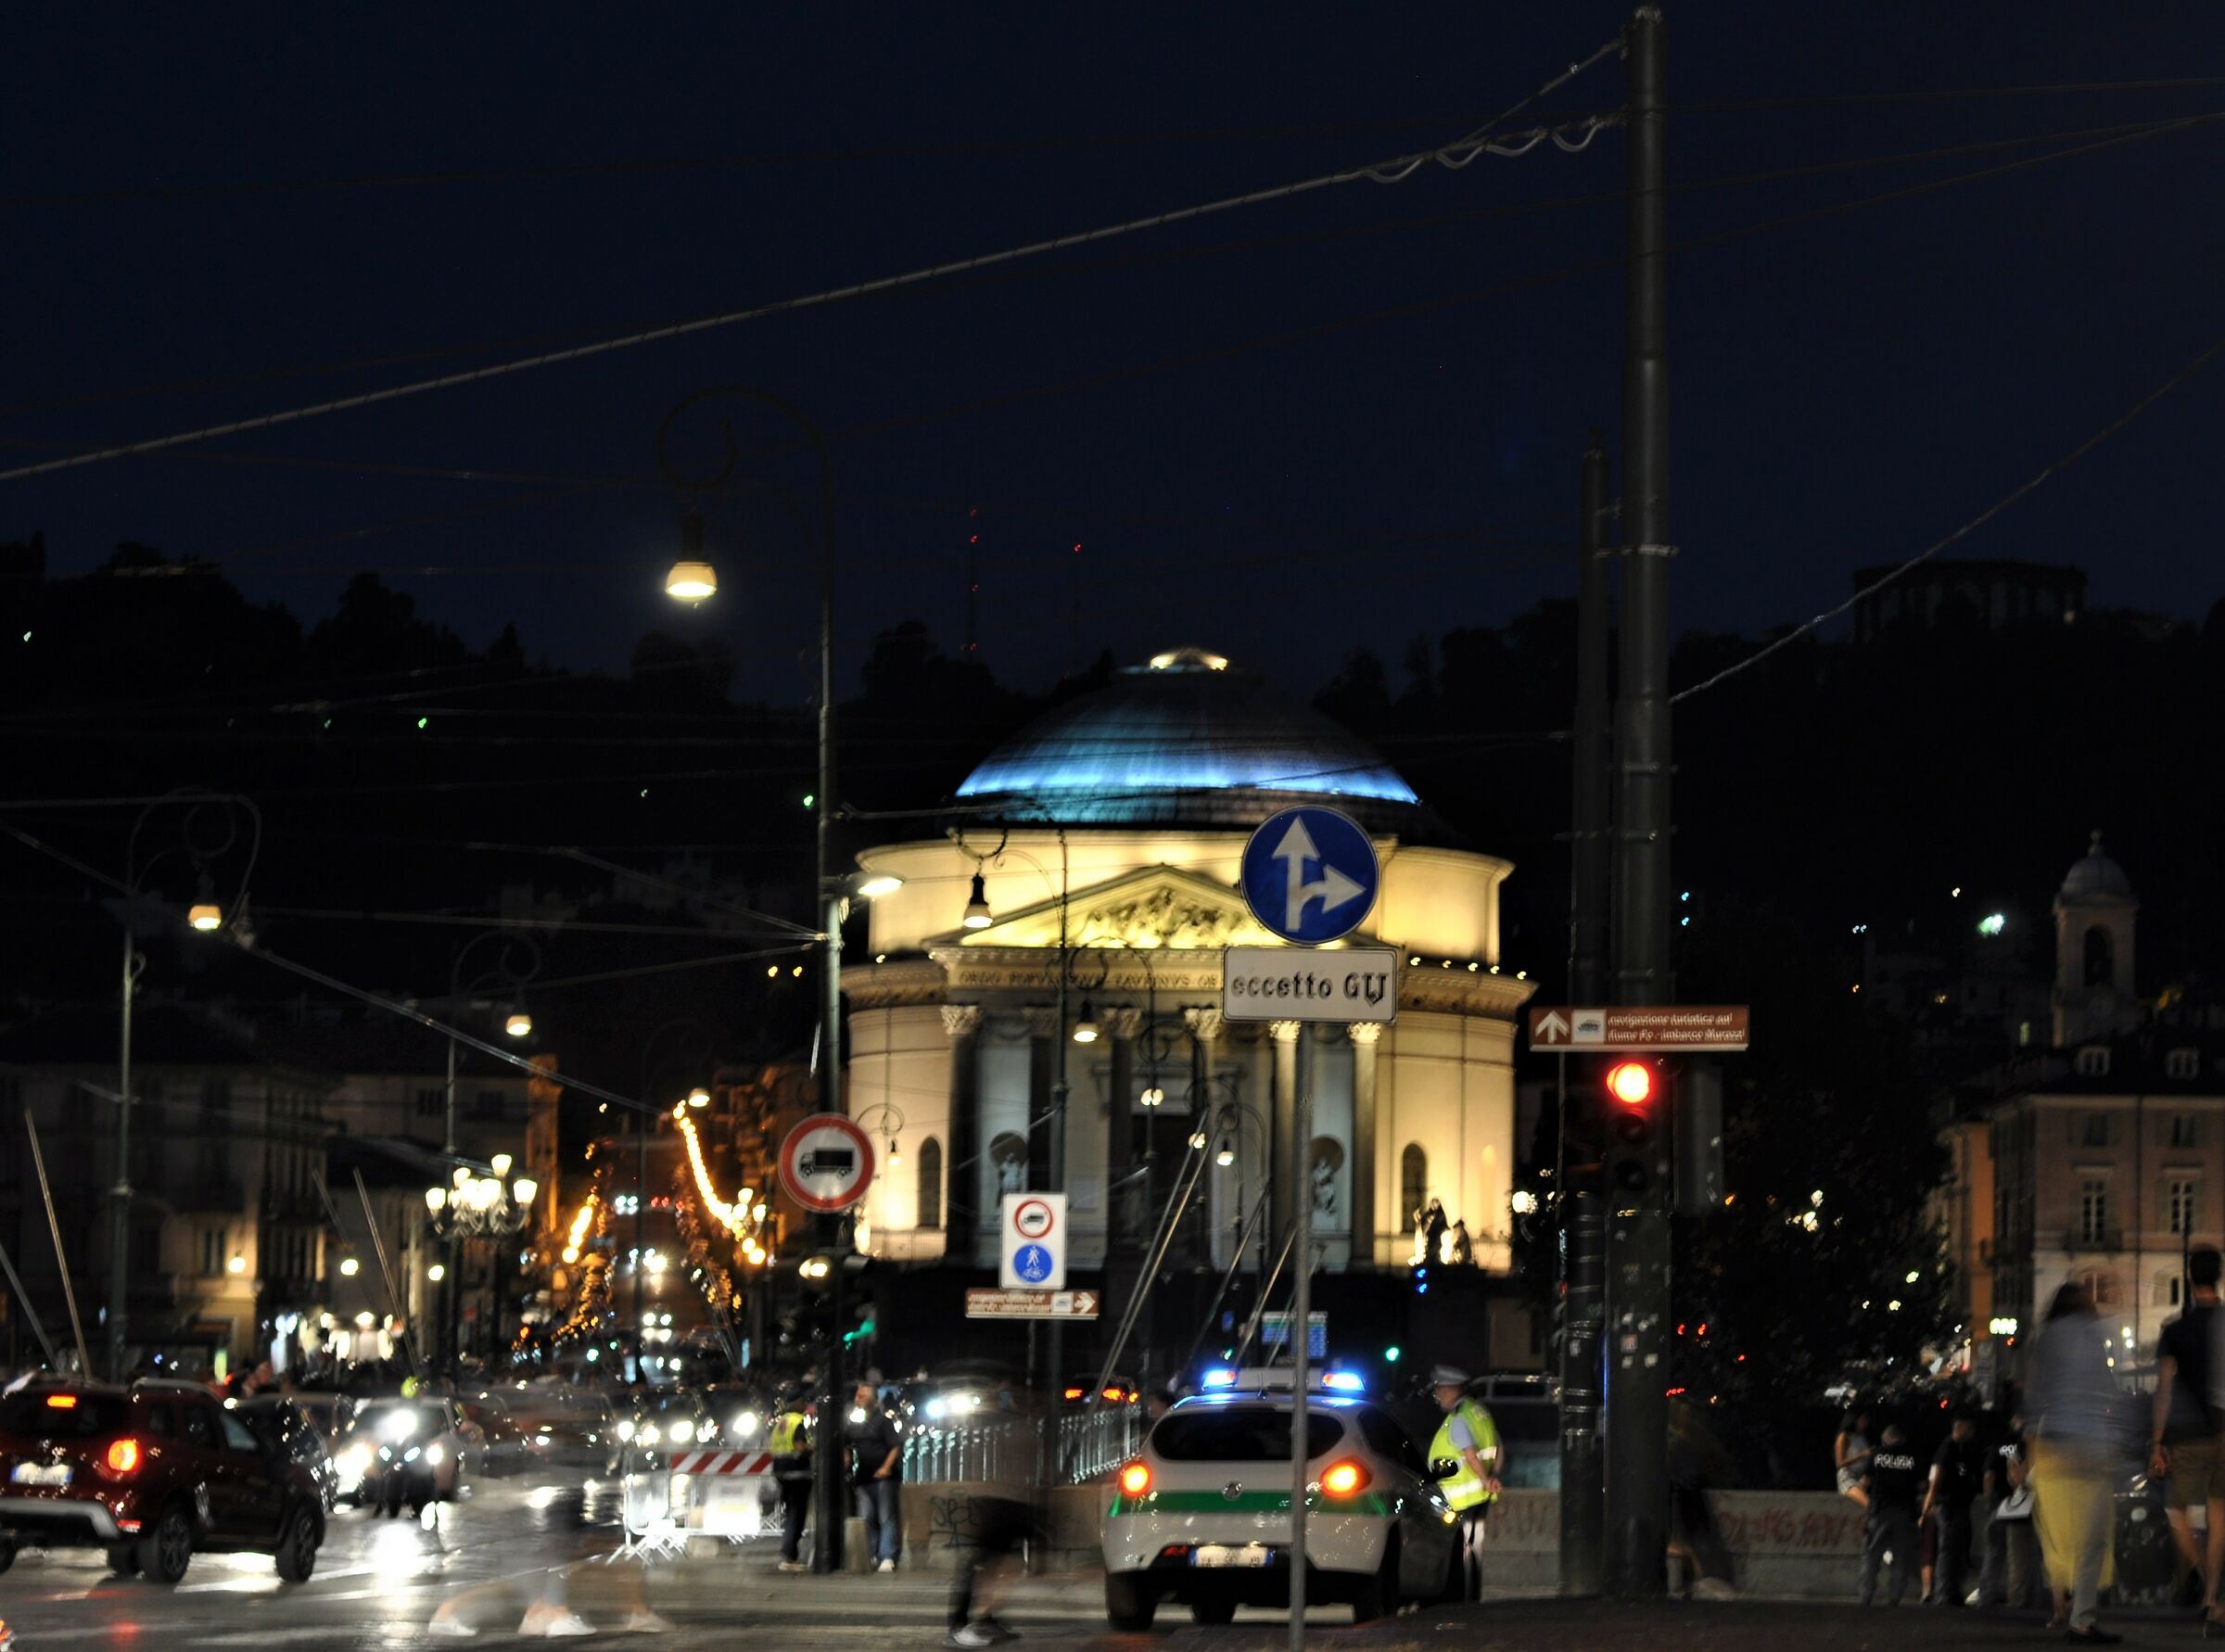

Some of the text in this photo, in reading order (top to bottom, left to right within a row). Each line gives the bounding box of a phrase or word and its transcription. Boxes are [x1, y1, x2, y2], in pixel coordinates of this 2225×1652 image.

[1231, 971, 1333, 999] eccetto
[1608, 1012, 1733, 1028] navigazione turistica sul
[1608, 1028, 1638, 1042] fiume
[1639, 1028, 1654, 1042] Po
[1660, 1028, 1704, 1042] imbarco
[1704, 1027, 1746, 1042] Murazzi
[1874, 1453, 1914, 1471] POLIZIA
